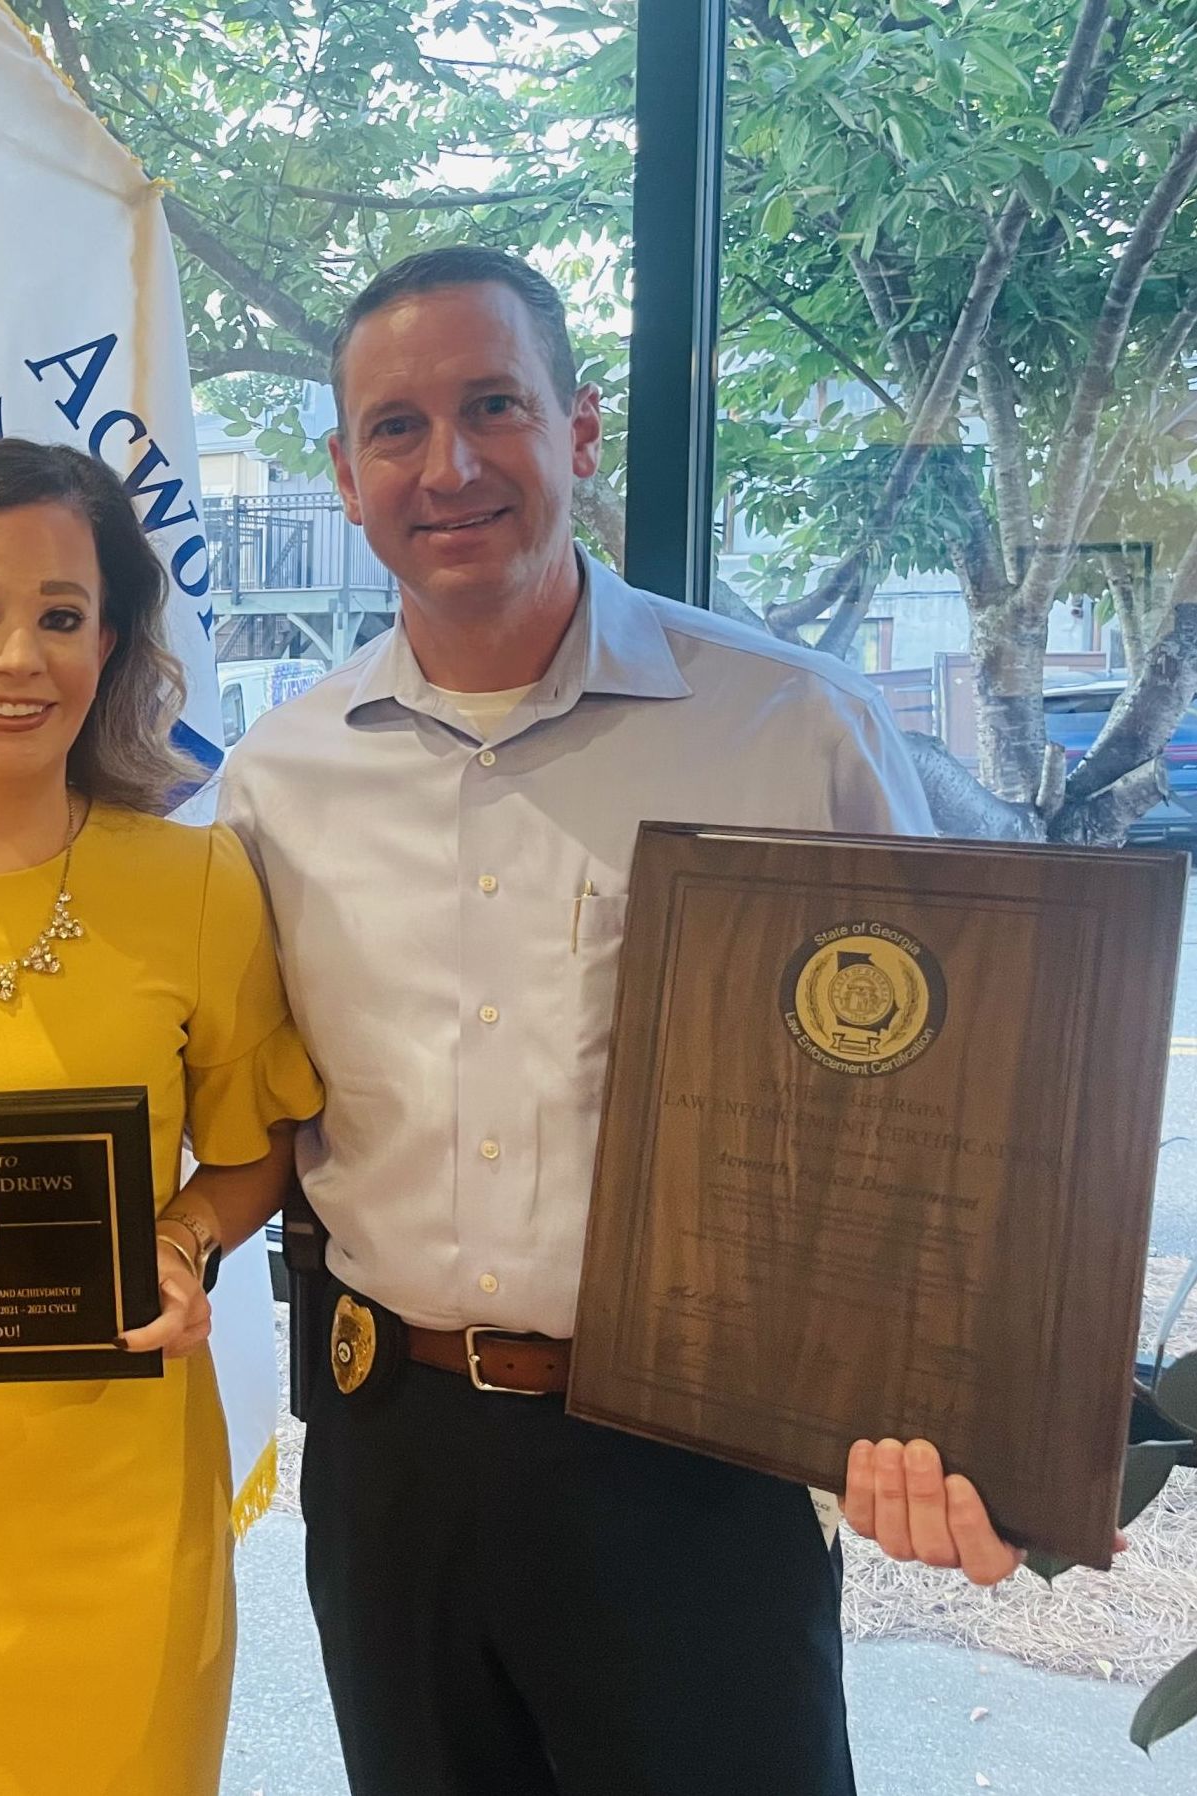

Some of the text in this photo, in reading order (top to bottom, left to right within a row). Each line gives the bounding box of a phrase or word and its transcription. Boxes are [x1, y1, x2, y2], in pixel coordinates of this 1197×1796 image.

[814, 922, 921, 956] State of Georgia
[785, 1011, 935, 1075] Law Enforcement Certification
[664, 1090, 705, 1110] LAW
[16, 1287, 69, 1298] ACHIEVEMENT
[71, 1286, 82, 1297] OF
[0, 1305, 19, 1315] 2021
[27, 1304, 47, 1314] 2023
[48, 1303, 77, 1314] CYCLE
